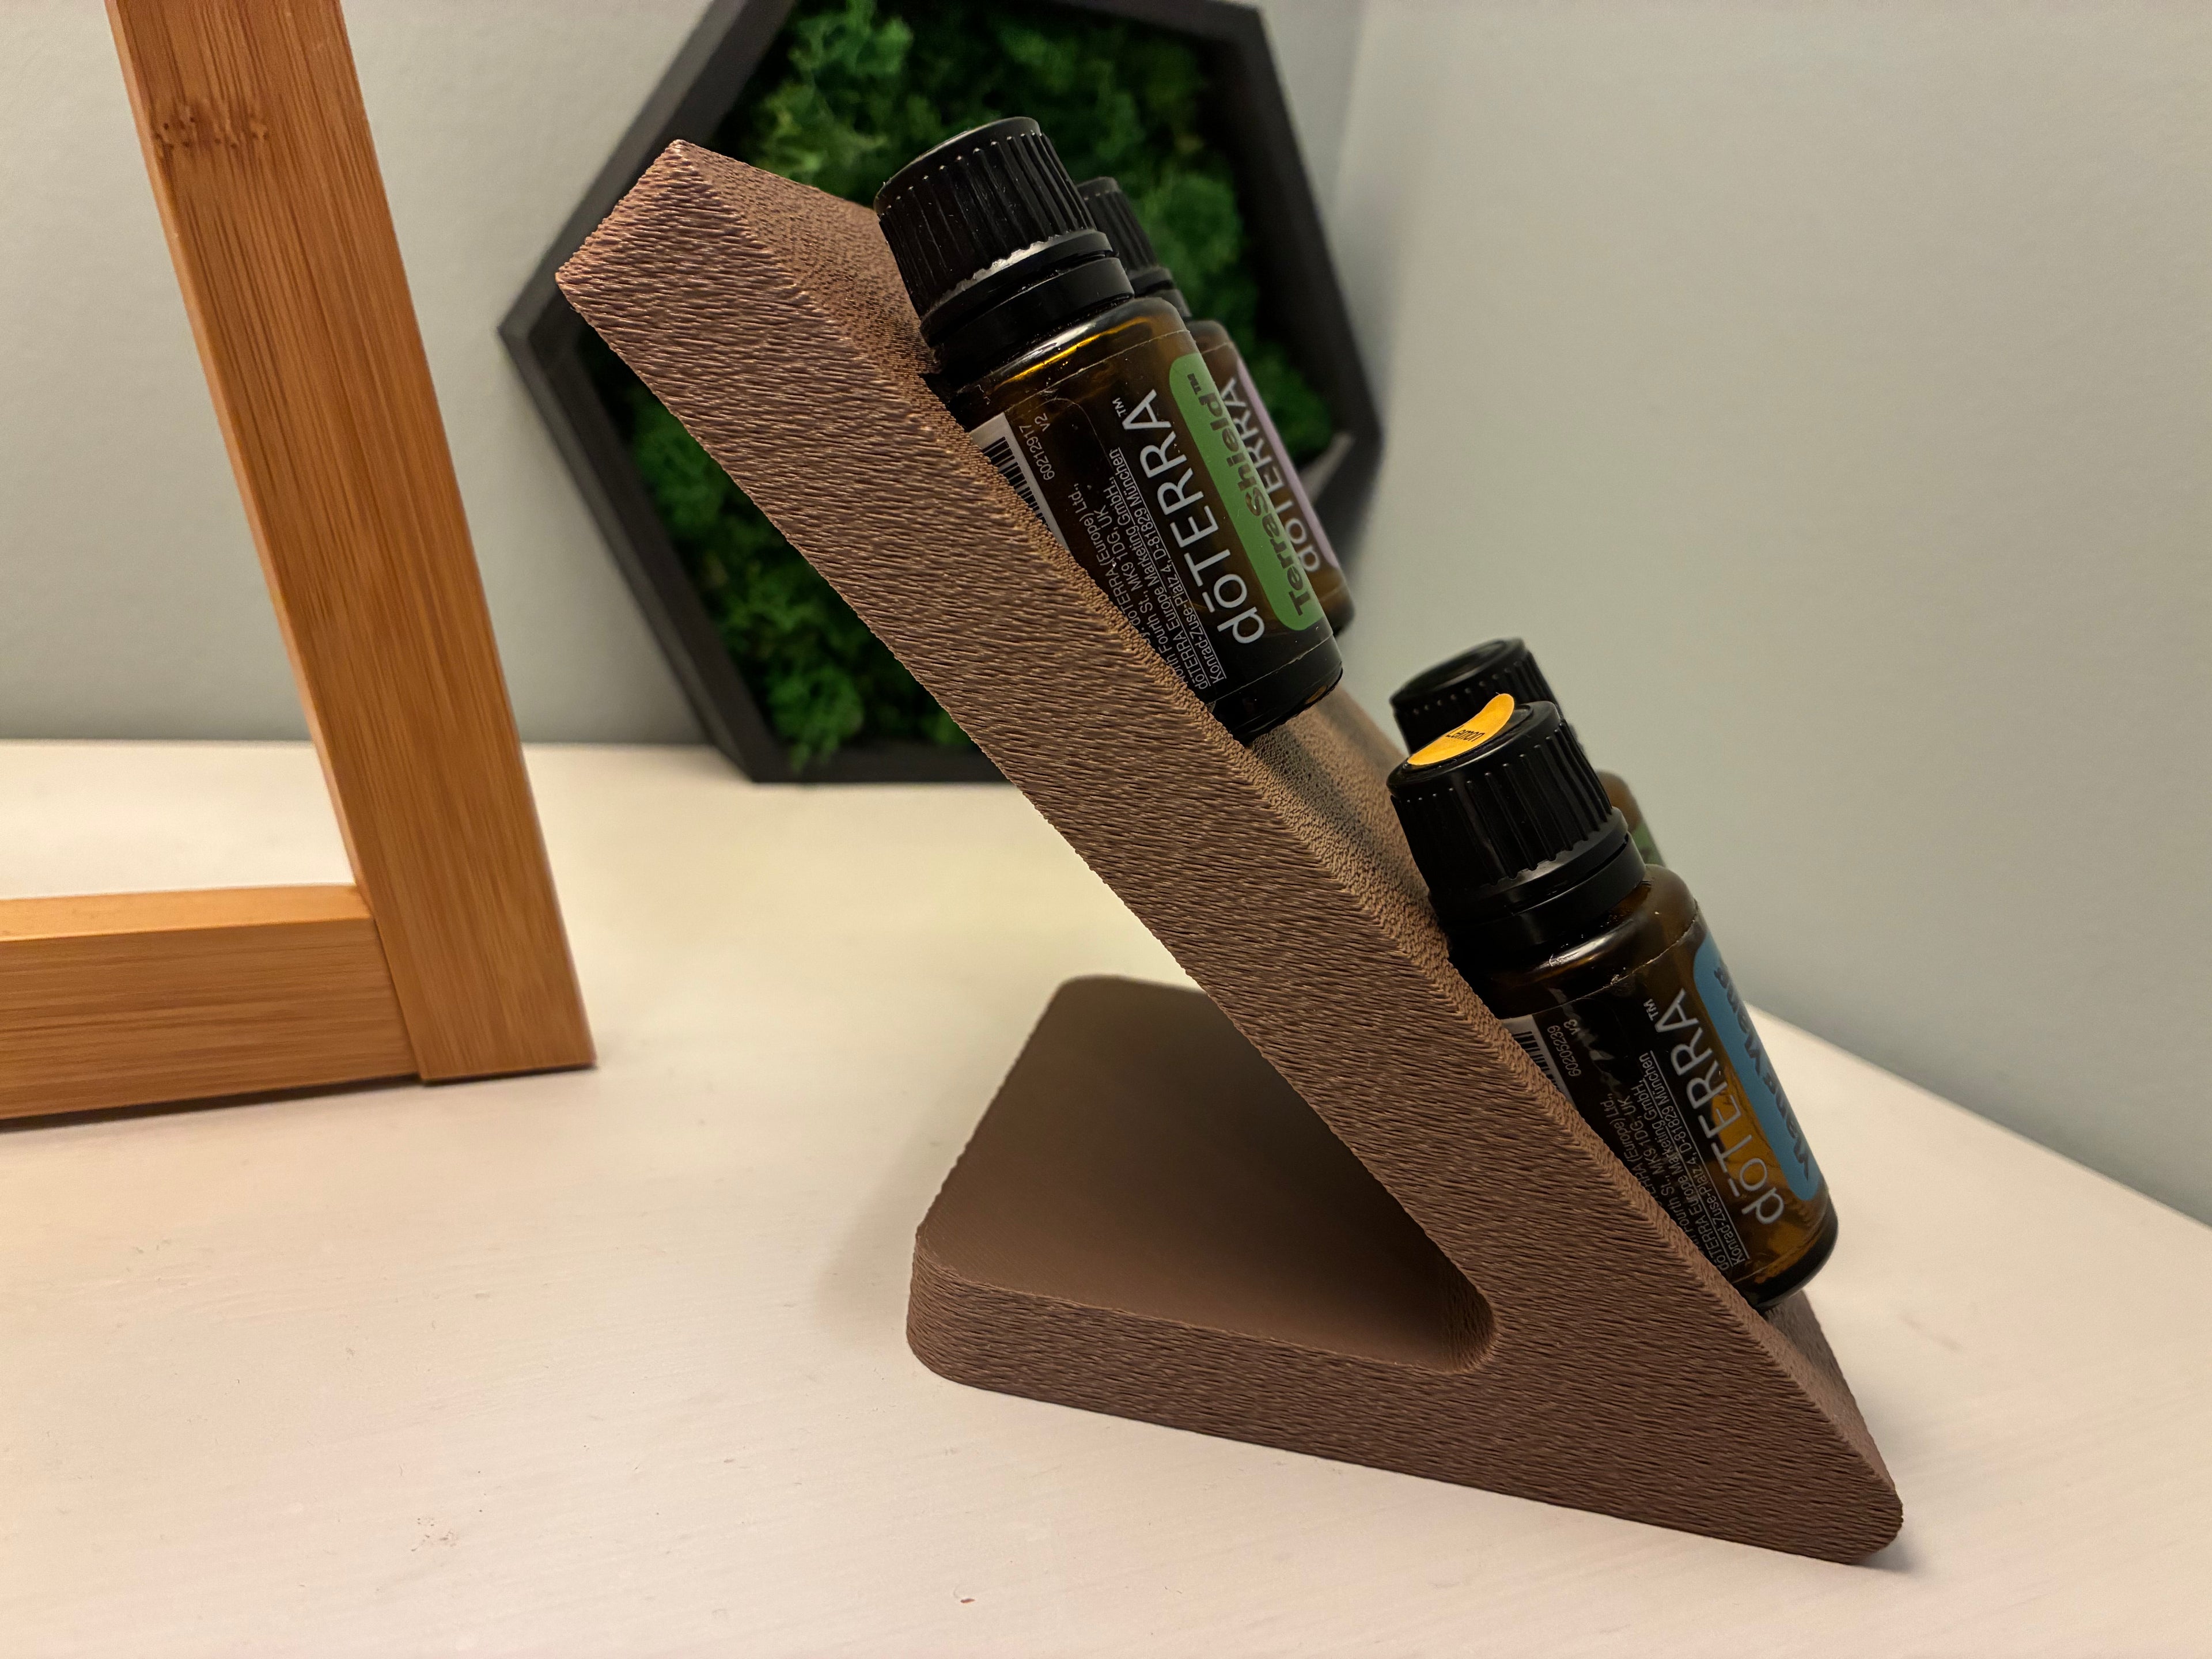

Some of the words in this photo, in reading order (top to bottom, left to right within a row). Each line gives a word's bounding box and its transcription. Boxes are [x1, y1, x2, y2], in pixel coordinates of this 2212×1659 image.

[1033, 411, 1052, 433] v2
[1018, 420, 1056, 482] 60212917
[1105, 447, 1142, 508] München
[1064, 482, 1089, 513] Ltd.,
[1093, 504, 1113, 528] UK
[1078, 510, 1115, 567] (Europe)
[1104, 525, 1130, 562] 1DG,
[1132, 505, 1167, 560] D-81829
[1120, 559, 1143, 591] MK9
[1122, 524, 1162, 588] Marketing
[1157, 558, 1175, 575] 4,
[1134, 589, 1156, 614] St.,
[1151, 584, 1183, 631] Europe
[1144, 612, 1173, 654] Fourth
[1164, 572, 1225, 685] Konrad-Zuse-Platz
[1445, 725, 1485, 742] Lemon
[1562, 1016, 1582, 1036] v3
[1546, 1022, 1583, 1079] 60205239
[1636, 1051, 1672, 1106] München
[1597, 1091, 1621, 1119] Ltd.,
[1617, 1093, 1638, 1116] UK
[1608, 1115, 1643, 1165] (Europe)
[1627, 1114, 1653, 1147] 1DG,
[1649, 1118, 1686, 1176] Marketing
[1661, 1103, 1695, 1153] D-81829
[1642, 1146, 1665, 1176] MK9
[1684, 1151, 1700, 1166] 4,
[1655, 1173, 1677, 1198] St.,
[1675, 1173, 1705, 1216] Europe
[1665, 1195, 1693, 1234] Fourth
[1688, 1164, 1746, 1266] Konrad-Zuse-Platz
